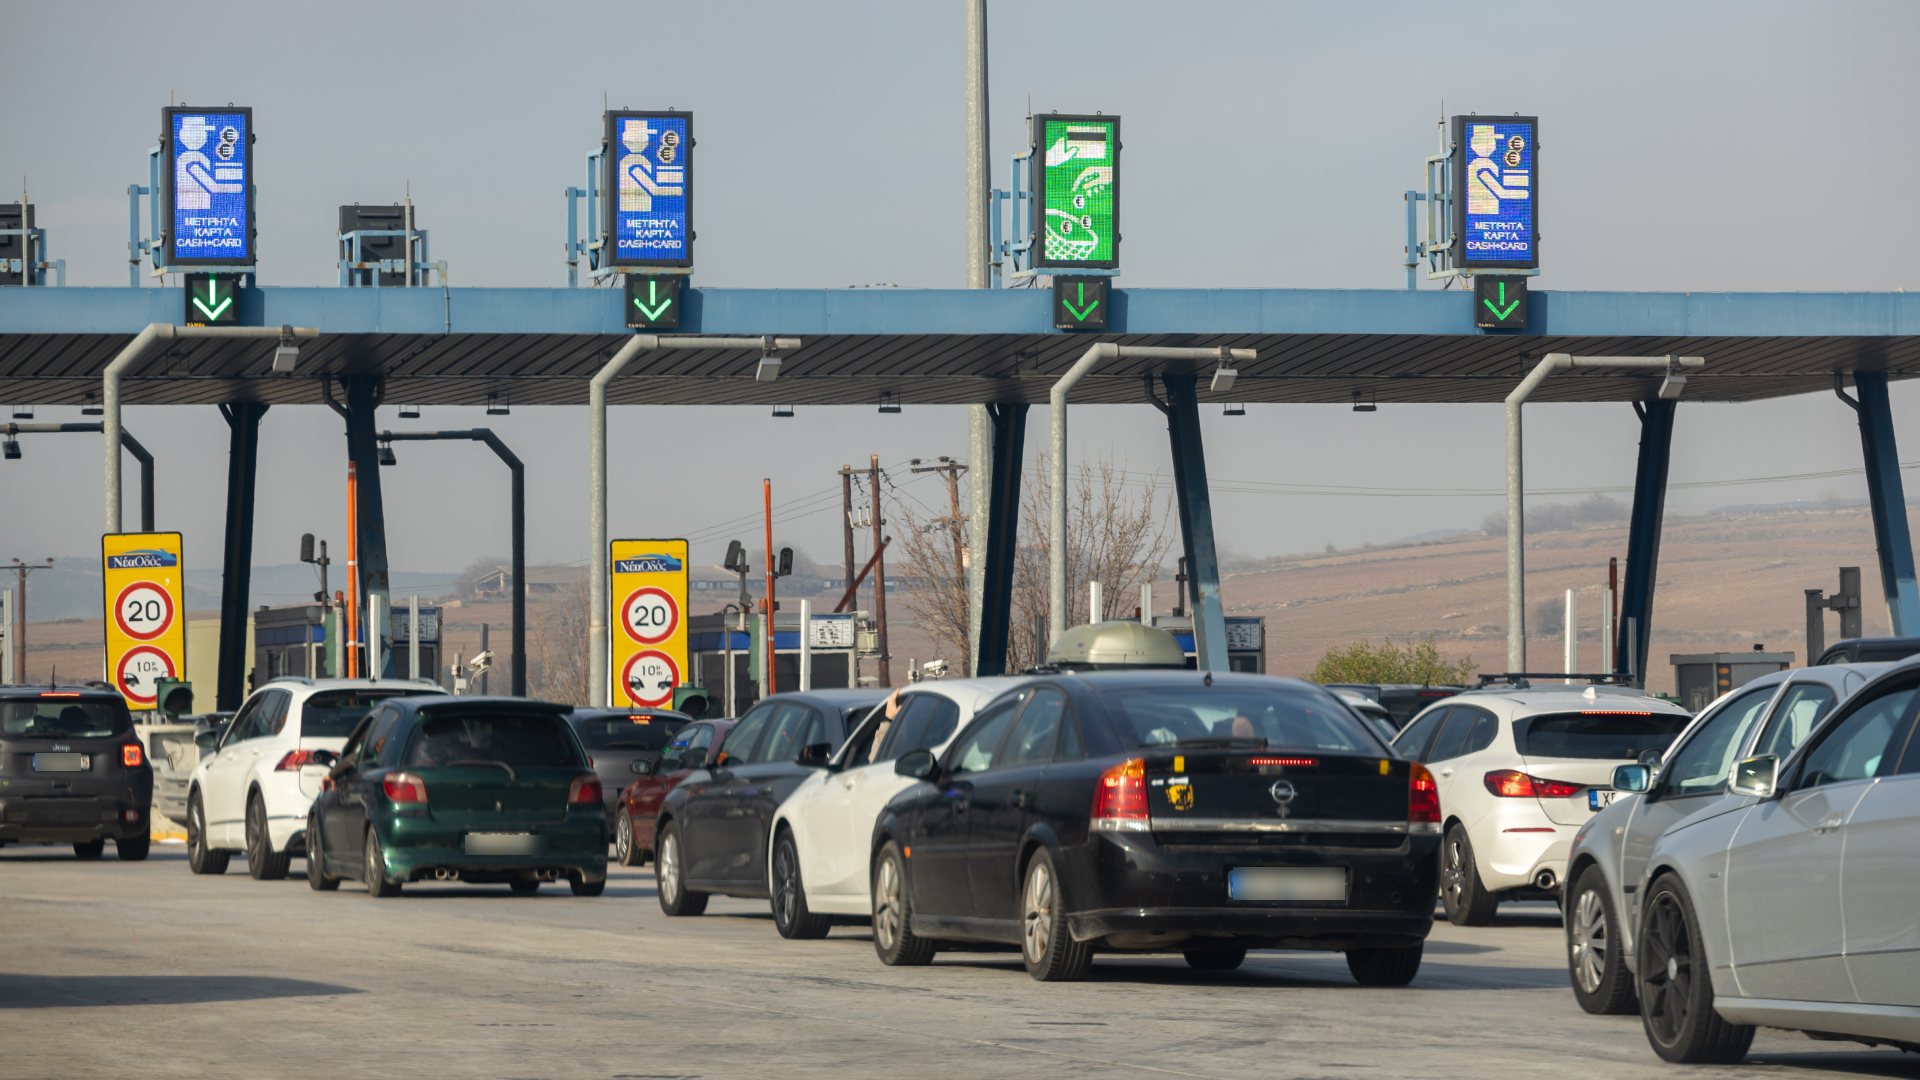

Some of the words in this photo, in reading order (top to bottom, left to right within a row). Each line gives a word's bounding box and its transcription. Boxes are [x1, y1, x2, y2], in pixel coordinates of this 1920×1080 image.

[194, 227, 232, 237] ΚΑΡΤΑ
[635, 229, 673, 239] ΚΑΡΤΑ
[1483, 231, 1520, 241] ΚΑΡΤΑ
[128, 600, 161, 622] 20
[634, 605, 666, 627] 20
[137, 661, 151, 673] 10
[642, 665, 656, 676] 10
[52, 744, 71, 753] Jeep
